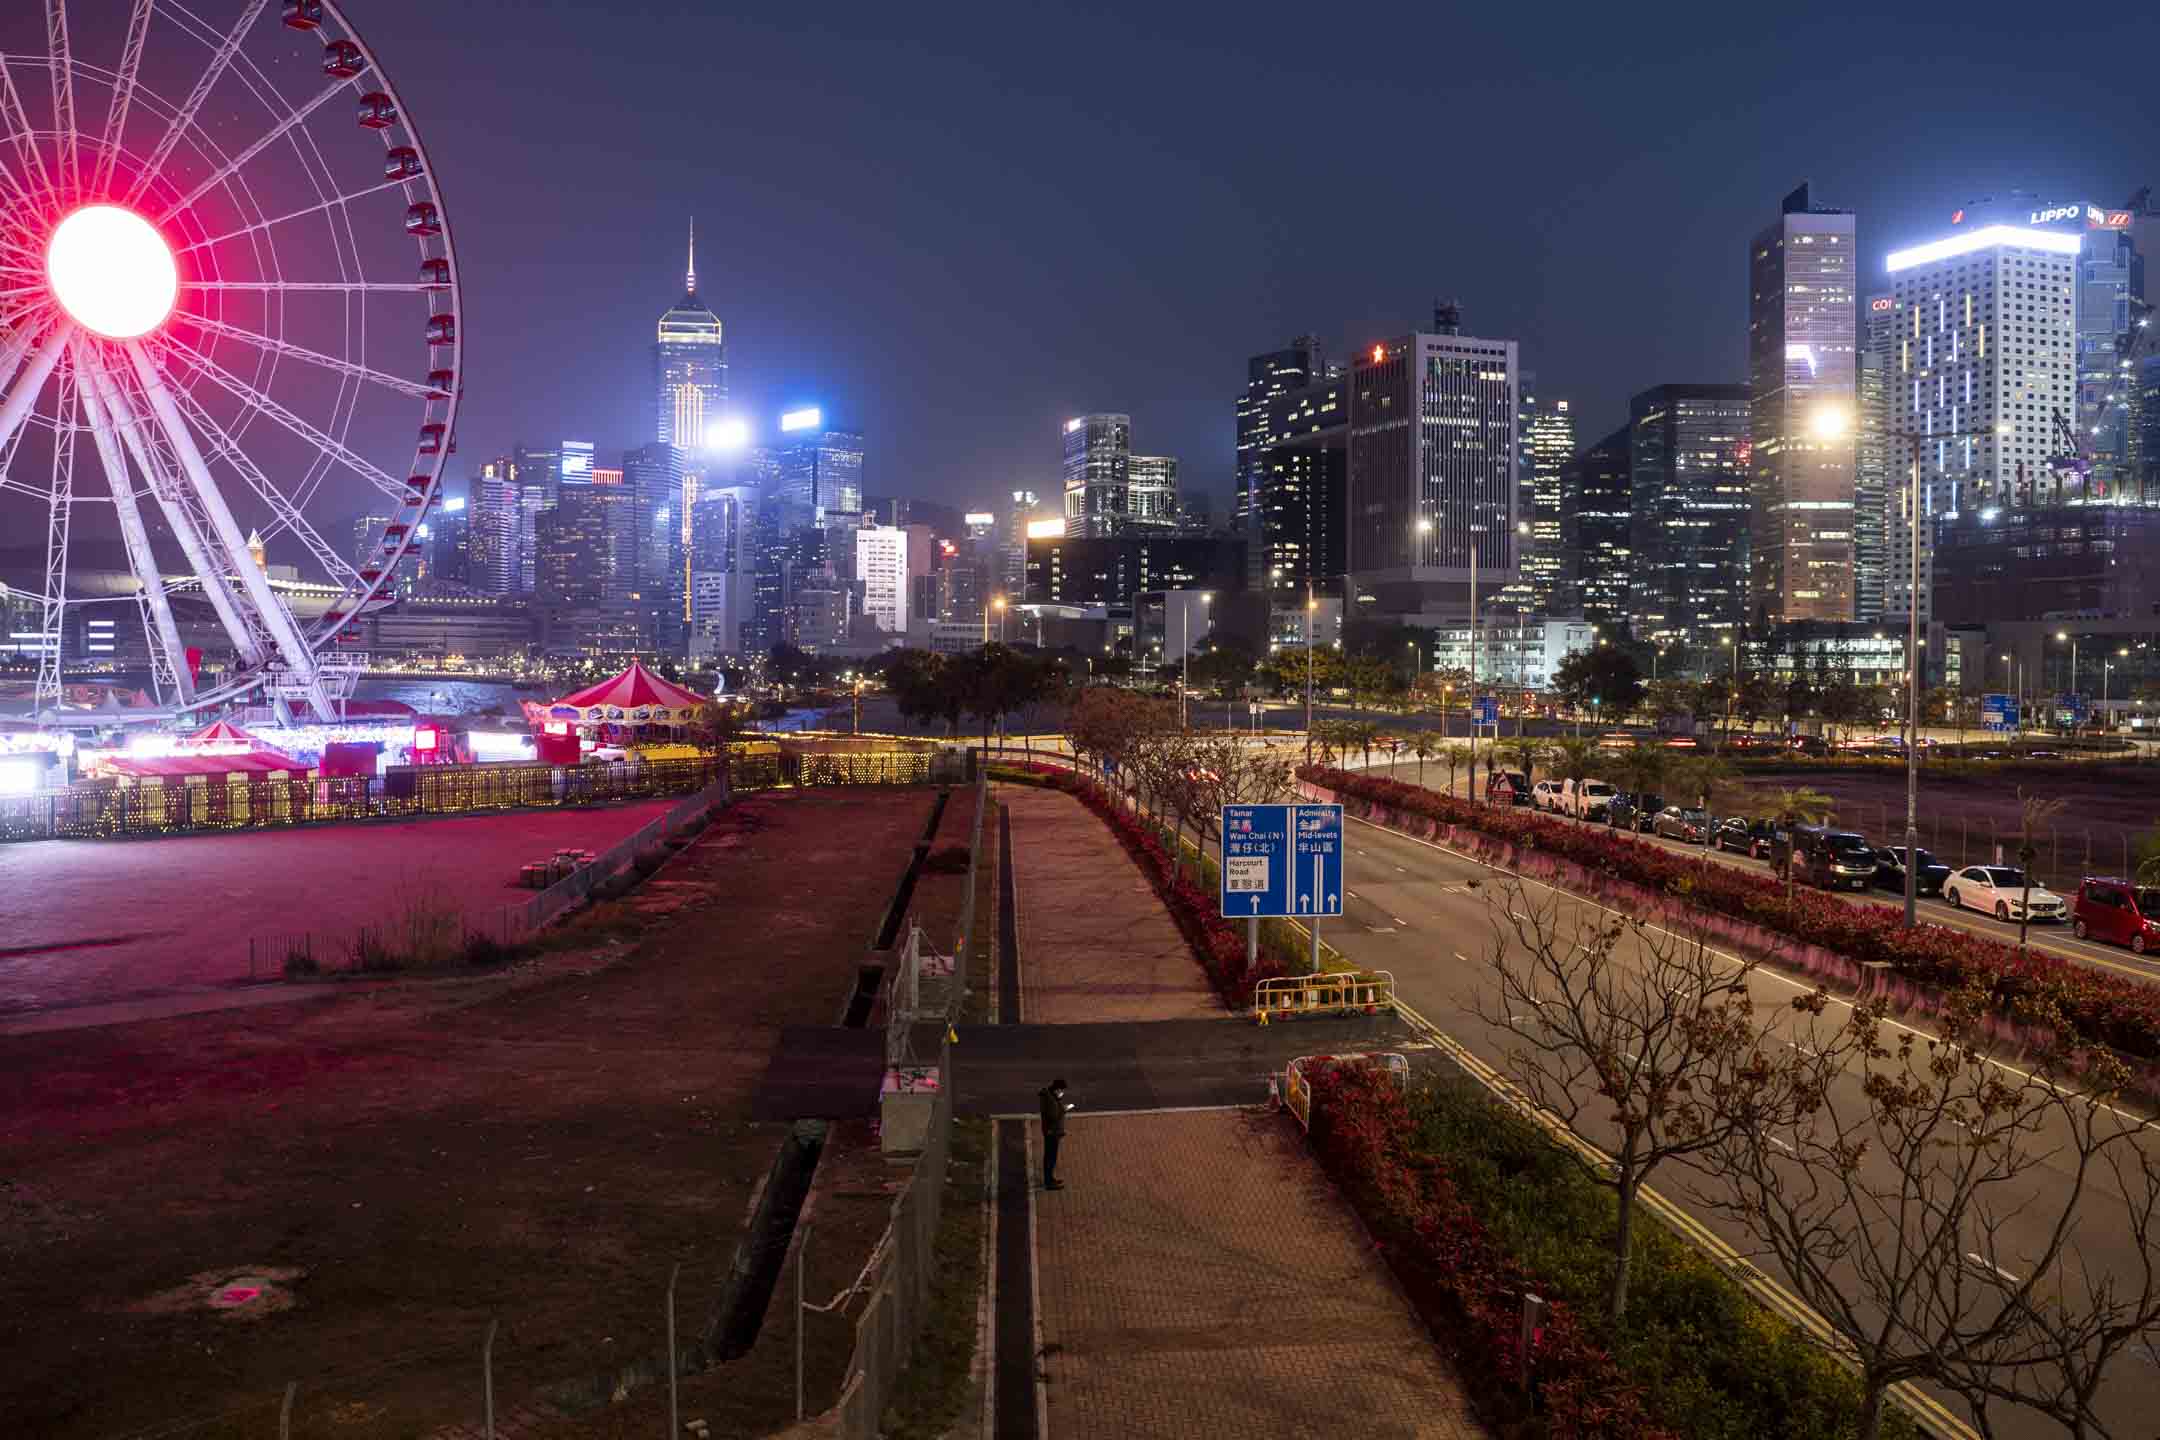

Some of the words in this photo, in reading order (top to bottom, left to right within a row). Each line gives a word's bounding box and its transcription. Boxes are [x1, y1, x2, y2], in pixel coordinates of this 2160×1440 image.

[2031, 205, 2080, 224] LIPPO
[1298, 809, 1336, 818] Admiralty
[1229, 832, 1247, 840] Wan
[1248, 831, 1267, 840] Chai
[1268, 831, 1285, 841] (N)
[1229, 859, 1264, 867] Harcourt
[1229, 868, 1250, 876] Road
